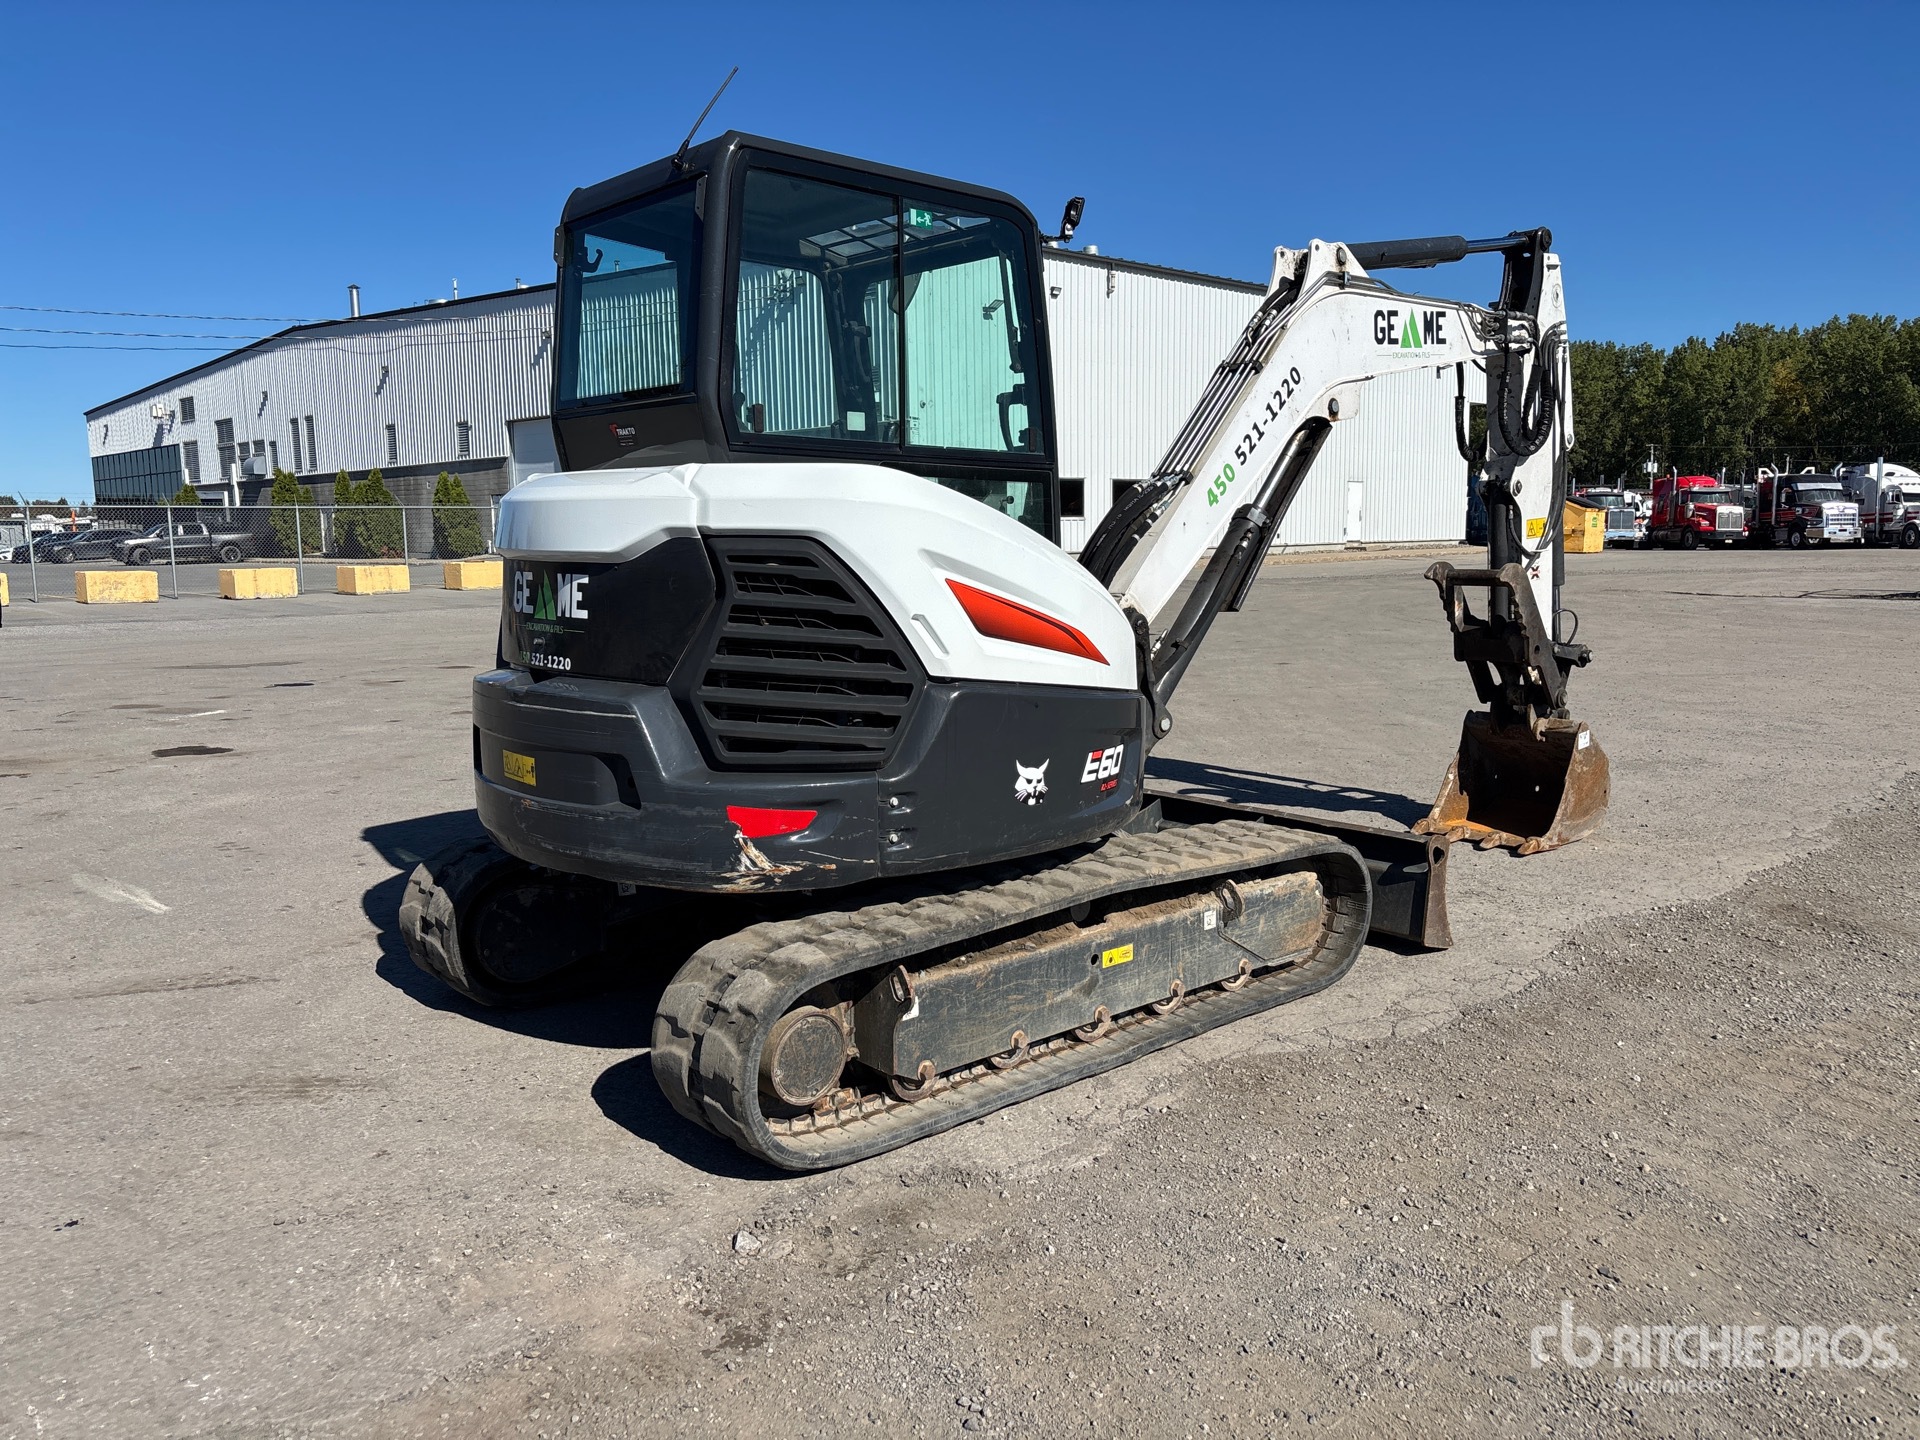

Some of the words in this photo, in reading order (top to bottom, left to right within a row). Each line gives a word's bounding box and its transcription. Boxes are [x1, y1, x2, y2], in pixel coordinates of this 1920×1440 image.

[1207, 463, 1236, 507] 450
[1234, 366, 1301, 466] 521-1220
[531, 652, 571, 671] 521-1220
[1081, 744, 1124, 783] E60
